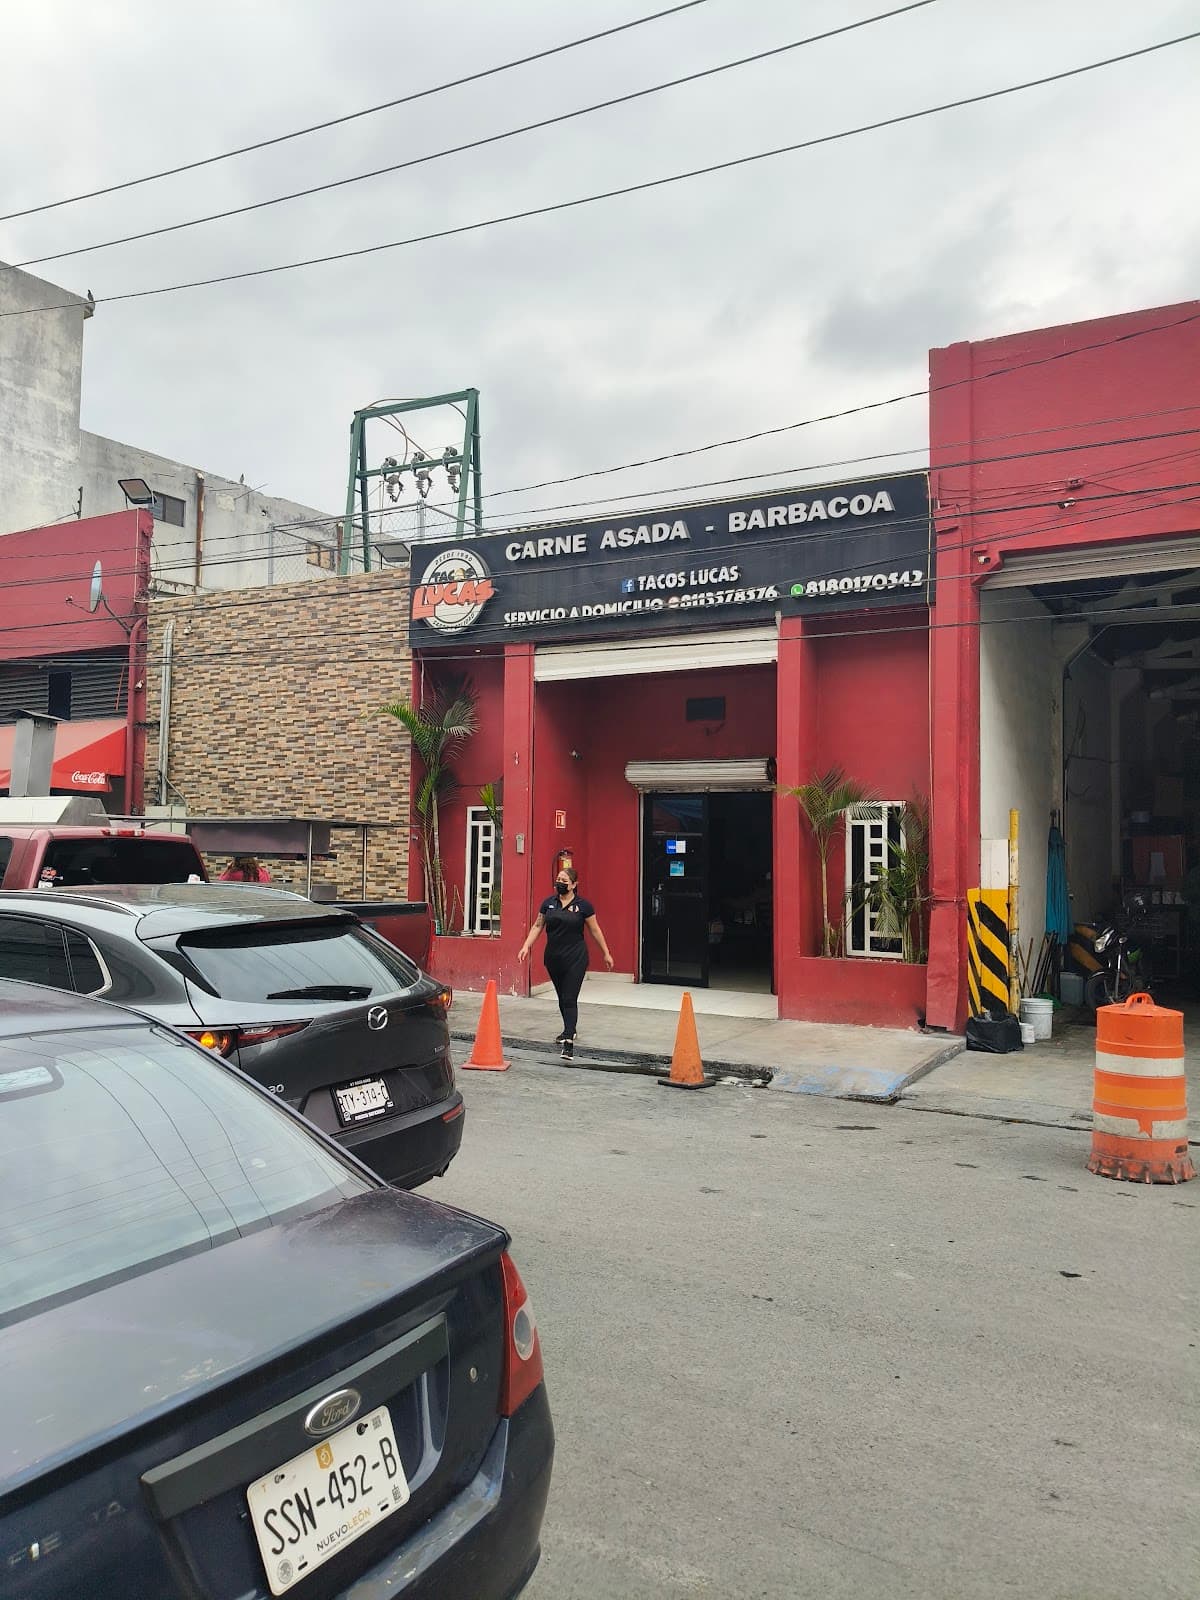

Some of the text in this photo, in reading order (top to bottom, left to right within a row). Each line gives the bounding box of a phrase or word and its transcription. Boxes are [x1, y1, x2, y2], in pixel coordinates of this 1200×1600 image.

[505, 534, 587, 561] CARNE
[599, 520, 690, 550] ASADA
[728, 490, 895, 532] BARBACOA
[638, 571, 686, 591] TACOS
[690, 565, 740, 586] LUCAS
[805, 570, 923, 597] 8180170542
[411, 579, 495, 620] LUCAS
[503, 598, 664, 627] SERVICIO A DOMICILIO
[321, 1399, 350, 1427] Ford
[263, 1436, 398, 1555] SSN-452-B
